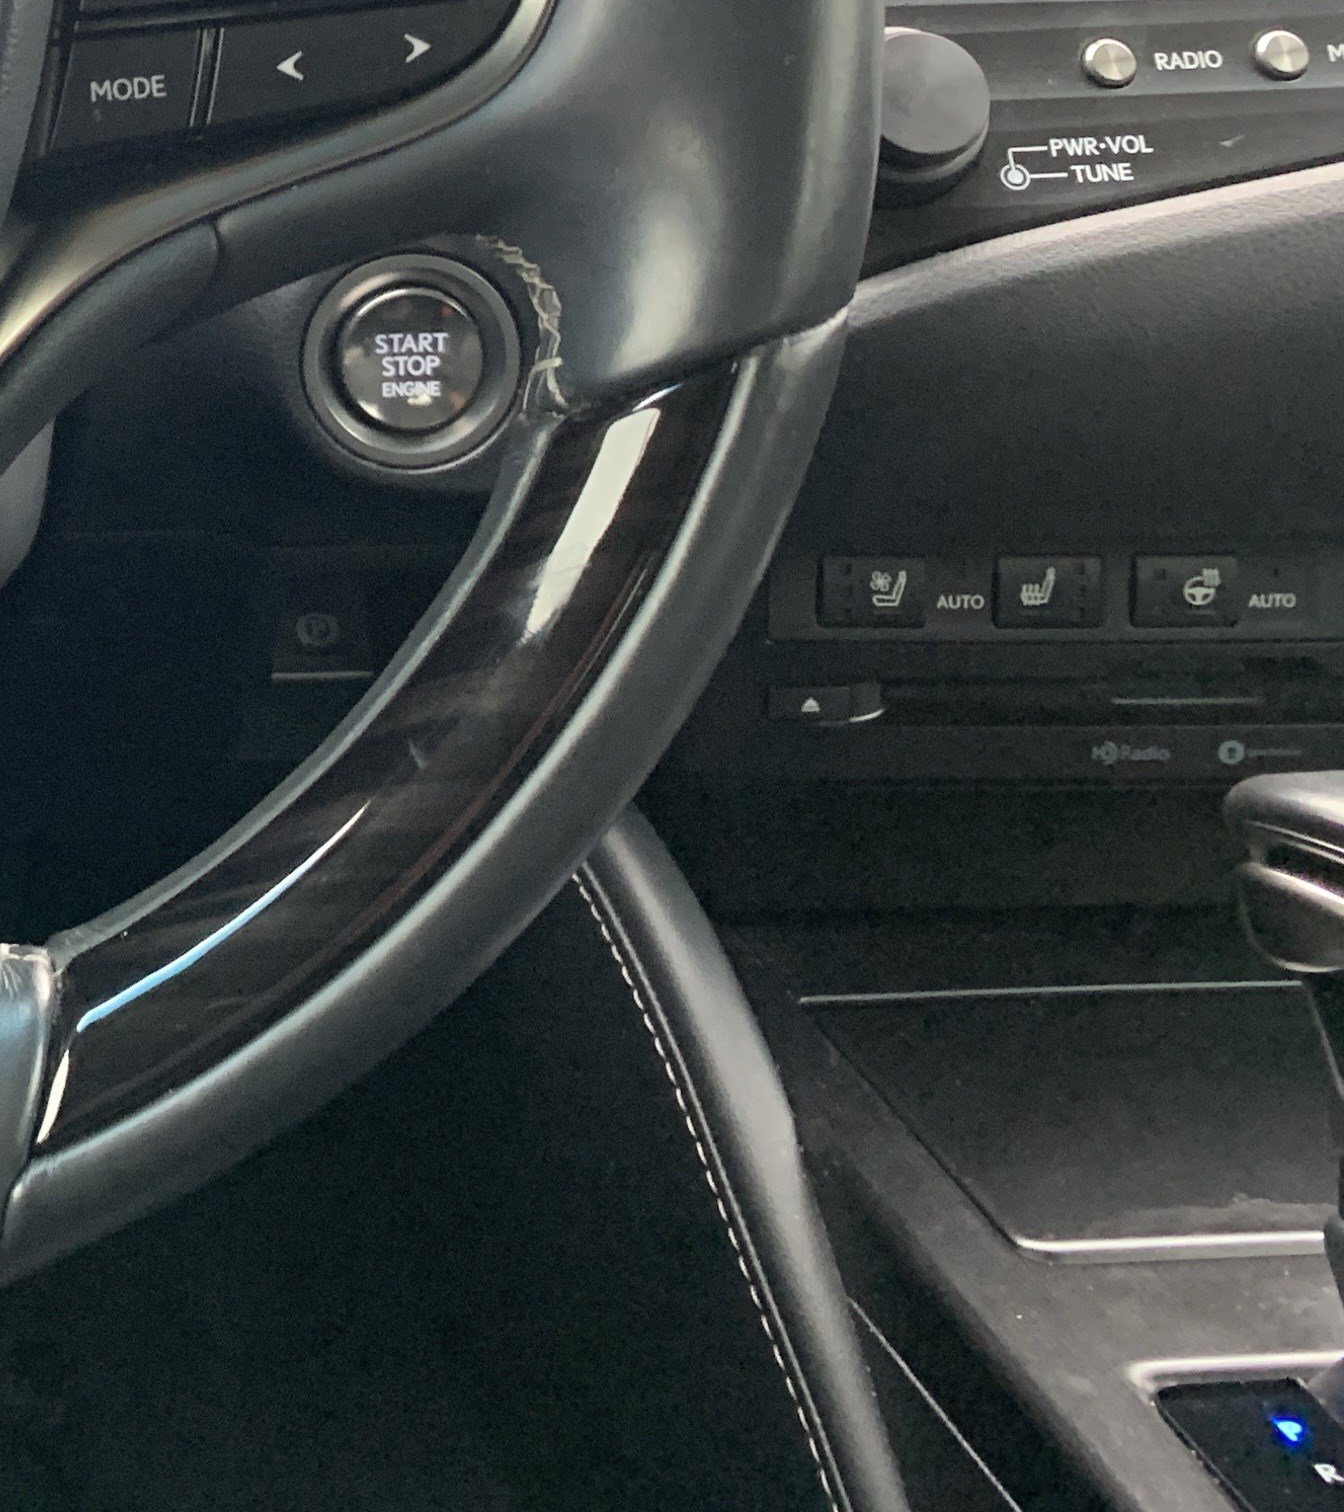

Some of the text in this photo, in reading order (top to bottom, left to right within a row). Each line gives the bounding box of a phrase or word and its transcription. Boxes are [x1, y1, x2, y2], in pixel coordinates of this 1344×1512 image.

[1154, 50, 1223, 71] RADIO
[89, 74, 167, 103] MODE
[1070, 162, 1135, 183] TUNE
[374, 332, 450, 355] START
[381, 355, 442, 377] STOP
[381, 380, 442, 398] ENGINE
[936, 593, 985, 610] AUTO
[1248, 592, 1297, 609] AUTO
